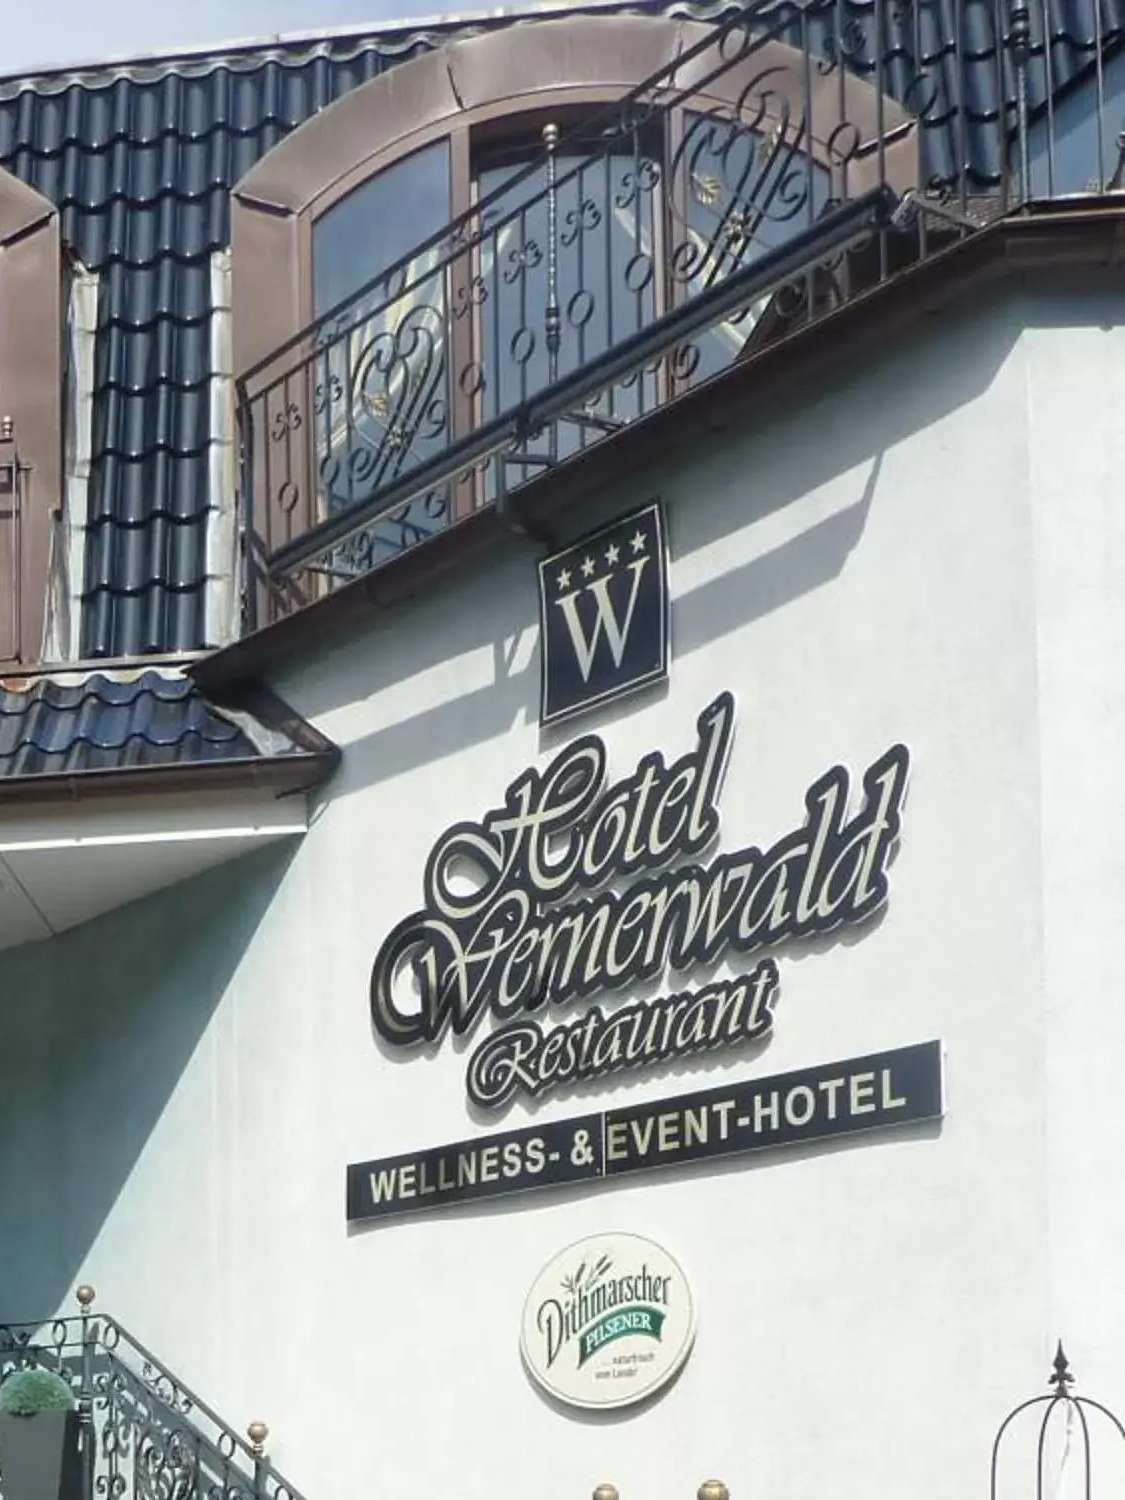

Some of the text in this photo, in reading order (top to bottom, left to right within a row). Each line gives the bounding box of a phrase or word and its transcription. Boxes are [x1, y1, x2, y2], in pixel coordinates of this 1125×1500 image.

[555, 556, 651, 683] W
[430, 700, 730, 918] Hotel
[375, 753, 904, 1036] Wernerwald
[470, 965, 776, 1102] Restaurant
[369, 1068, 906, 1204] WELLNESS- & EVENT-HOTEL
[536, 1263, 672, 1369] Dithmarscher
[585, 1311, 653, 1354] PILSENER
